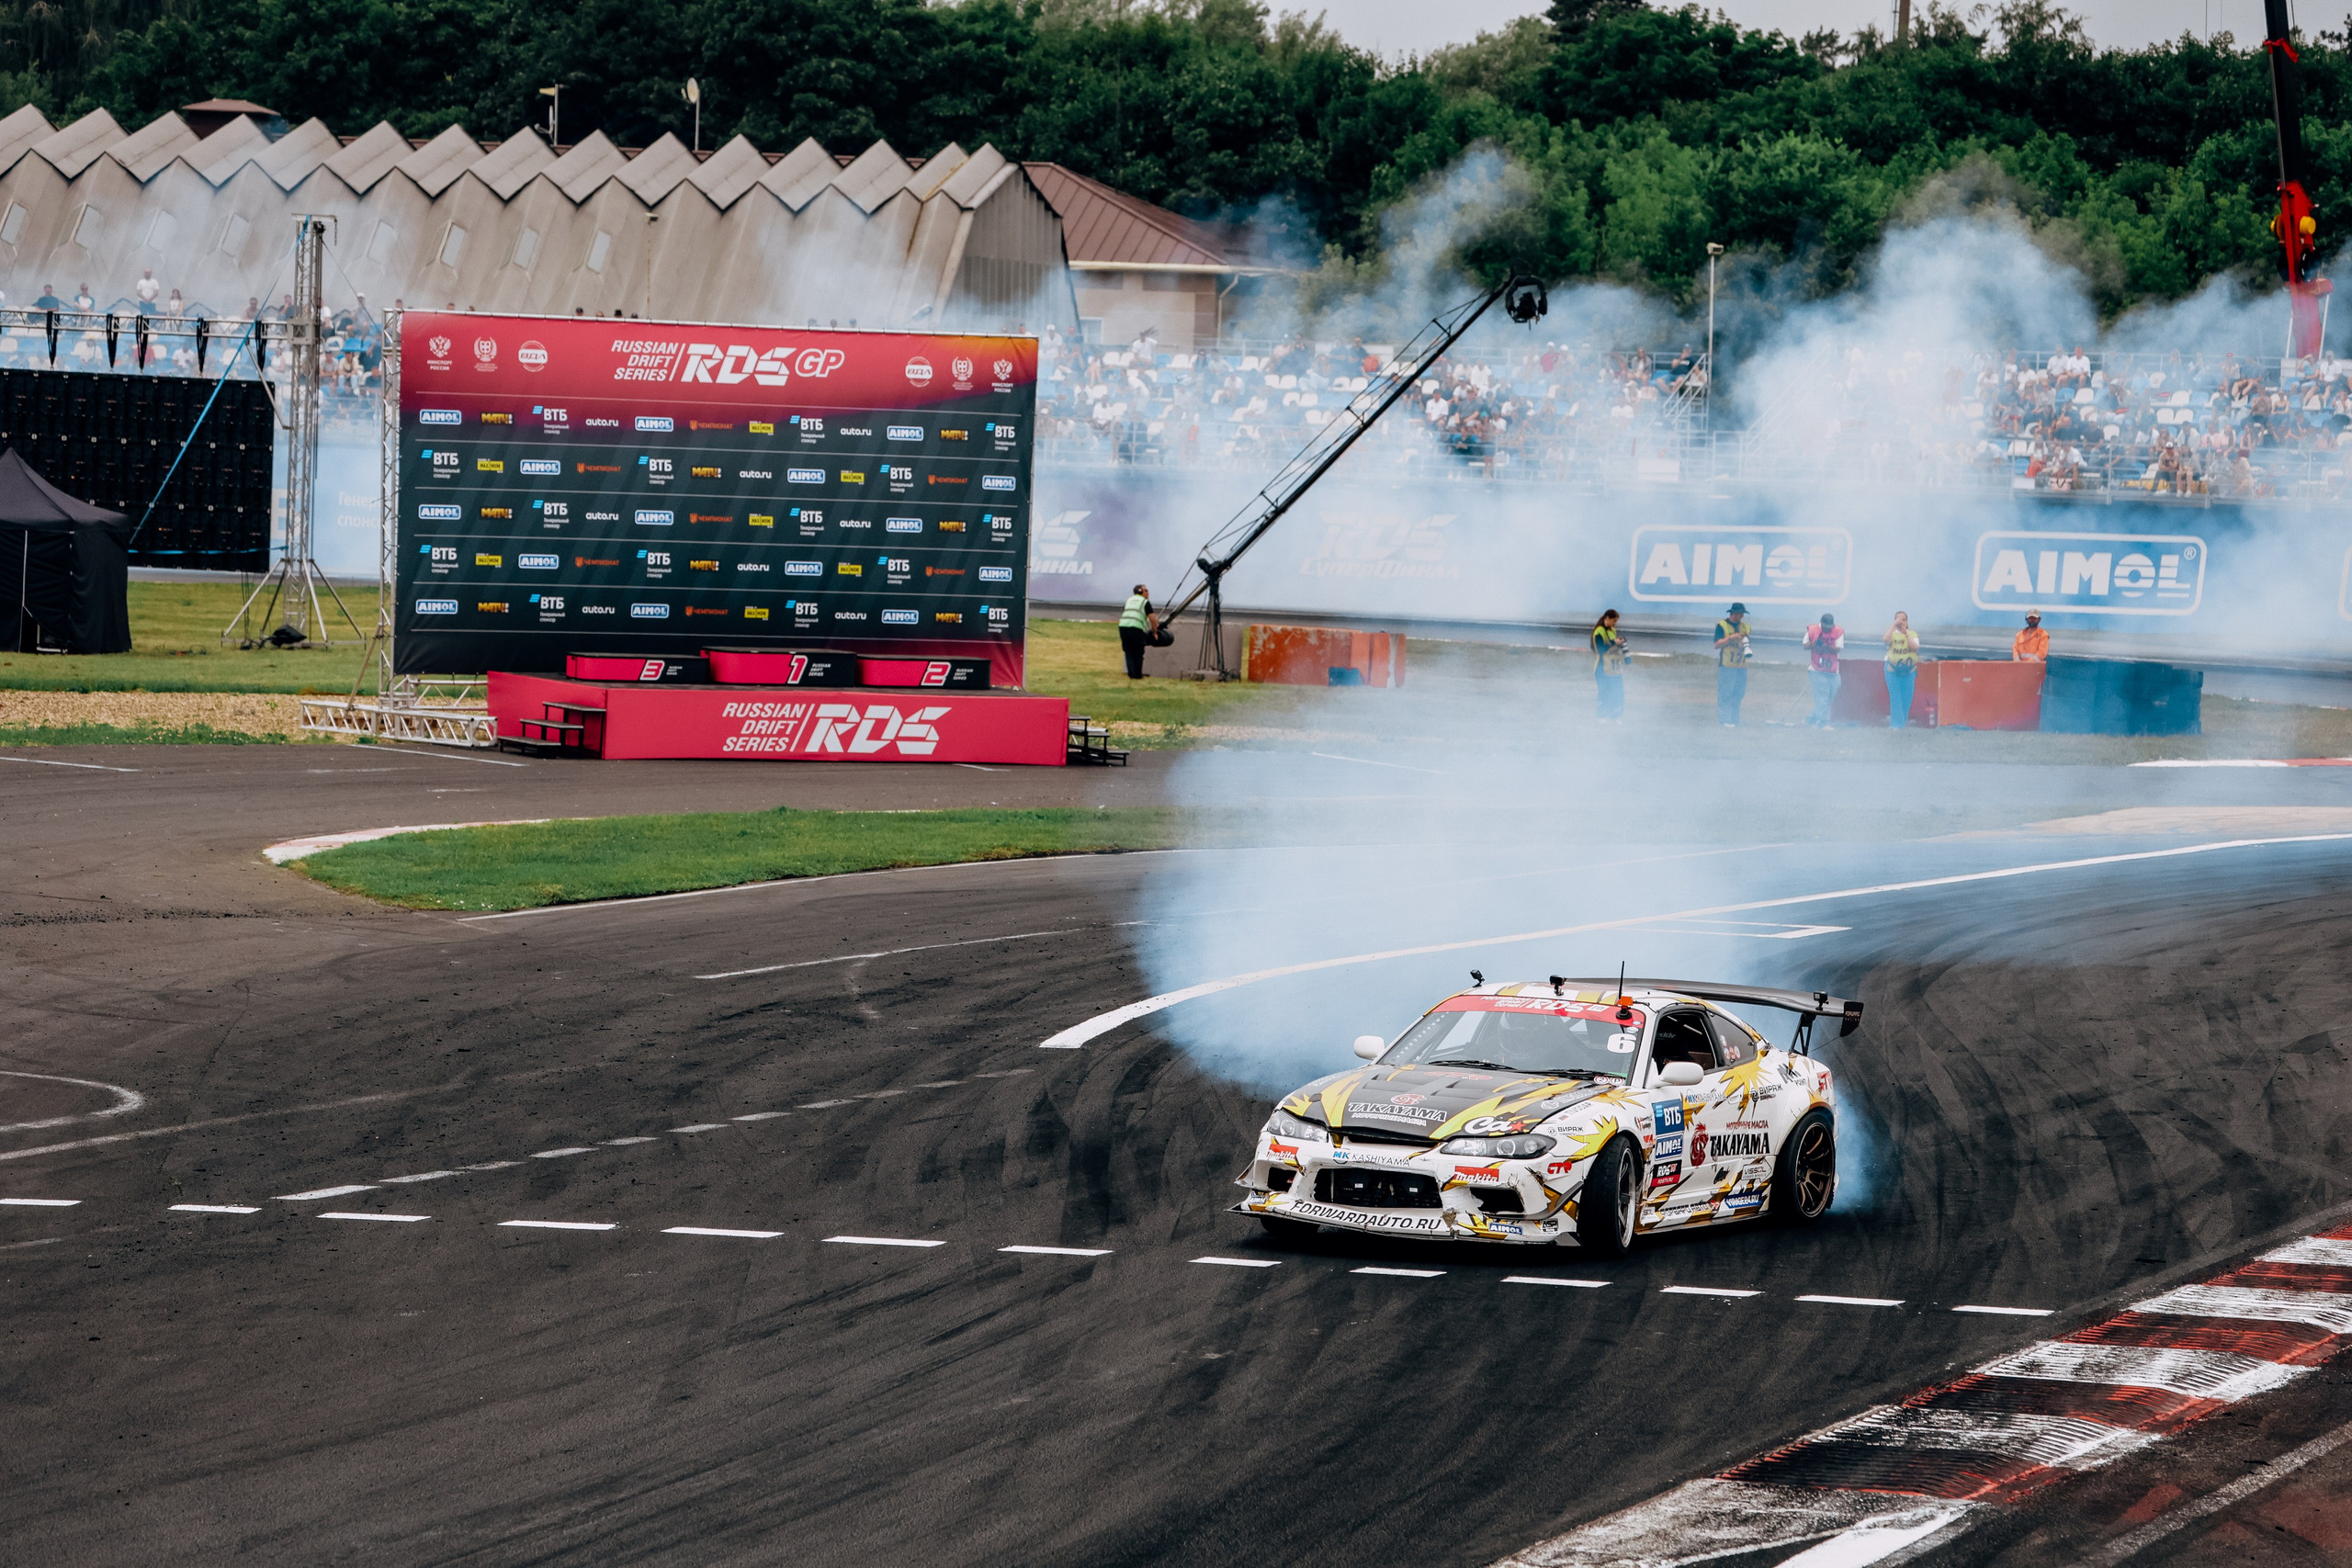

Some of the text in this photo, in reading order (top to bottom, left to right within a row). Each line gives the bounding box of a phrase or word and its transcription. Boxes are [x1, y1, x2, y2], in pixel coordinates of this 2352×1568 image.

[611, 341, 678, 355] RUSSIAN
[628, 355, 673, 367] DRIFT
[681, 344, 844, 386] RDS GP
[614, 367, 667, 381] SERIES
[422, 412, 459, 423] AIMOL
[544, 409, 567, 422] ВТБ
[586, 417, 618, 427] auto.ru
[637, 419, 672, 429] AIMOL
[800, 418, 823, 431] ВТБ
[841, 427, 872, 436] auto.ru
[889, 428, 922, 439] AIMOL
[995, 425, 1015, 438] ВТБ
[434, 453, 458, 465] ВТБ
[650, 459, 672, 471] ВТБ
[522, 462, 559, 473] AIMOL
[890, 467, 911, 479] ВТБ
[740, 469, 772, 479] auto.ru
[789, 470, 823, 481] AIMOL
[984, 478, 1014, 489] AIMOL
[421, 506, 459, 517] AIMOL
[544, 503, 567, 515] ВТБ
[586, 512, 618, 521] auto.ru
[637, 512, 672, 523] AIMOL
[800, 510, 822, 523] ВТБ
[840, 519, 871, 528] auto.ru
[888, 520, 921, 531] AIMOL
[991, 517, 1012, 529] ВТБ
[1317, 511, 1461, 560] RDS
[432, 547, 457, 560] ВТБ
[648, 553, 671, 565] ВТБ
[520, 556, 558, 567] AIMOL
[737, 563, 769, 572] auto.ru
[888, 558, 910, 571] ВТБ
[786, 563, 821, 574] AIMOL
[981, 569, 1011, 580] AIMOL
[417, 601, 456, 612] AIMOL
[540, 597, 564, 609] ВТБ
[796, 603, 818, 615] ВТБ
[582, 605, 615, 615] auto.ru
[633, 605, 667, 616] AIMOL
[835, 611, 866, 620] auto.ru
[989, 608, 1008, 620] ВТБ
[884, 612, 917, 623] AIMOL
[639, 660, 664, 681] 3
[787, 655, 808, 683] 1
[921, 662, 951, 686] 2
[722, 703, 803, 718] RUSSIAN
[741, 720, 797, 735] DRIFT
[805, 704, 952, 754] RDS
[722, 737, 788, 752] SERIES
[1527, 998, 1588, 1012] RDS
[1607, 1033, 1637, 1053] 6
[1758, 1084, 1783, 1095] ВИРАЖ
[1348, 1102, 1448, 1122] TAKAYAMA
[1663, 1106, 1681, 1126] ВТБ
[1656, 1139, 1682, 1156] AIMOL
[1710, 1133, 1770, 1156] TAKAYAMA
[1333, 1151, 1411, 1167] MK KASHIYAMA
[1657, 1165, 1671, 1177] RDS
[1290, 1201, 1442, 1231] FORWARDAUTO.RU
[1490, 1224, 1521, 1235] AIMOL
